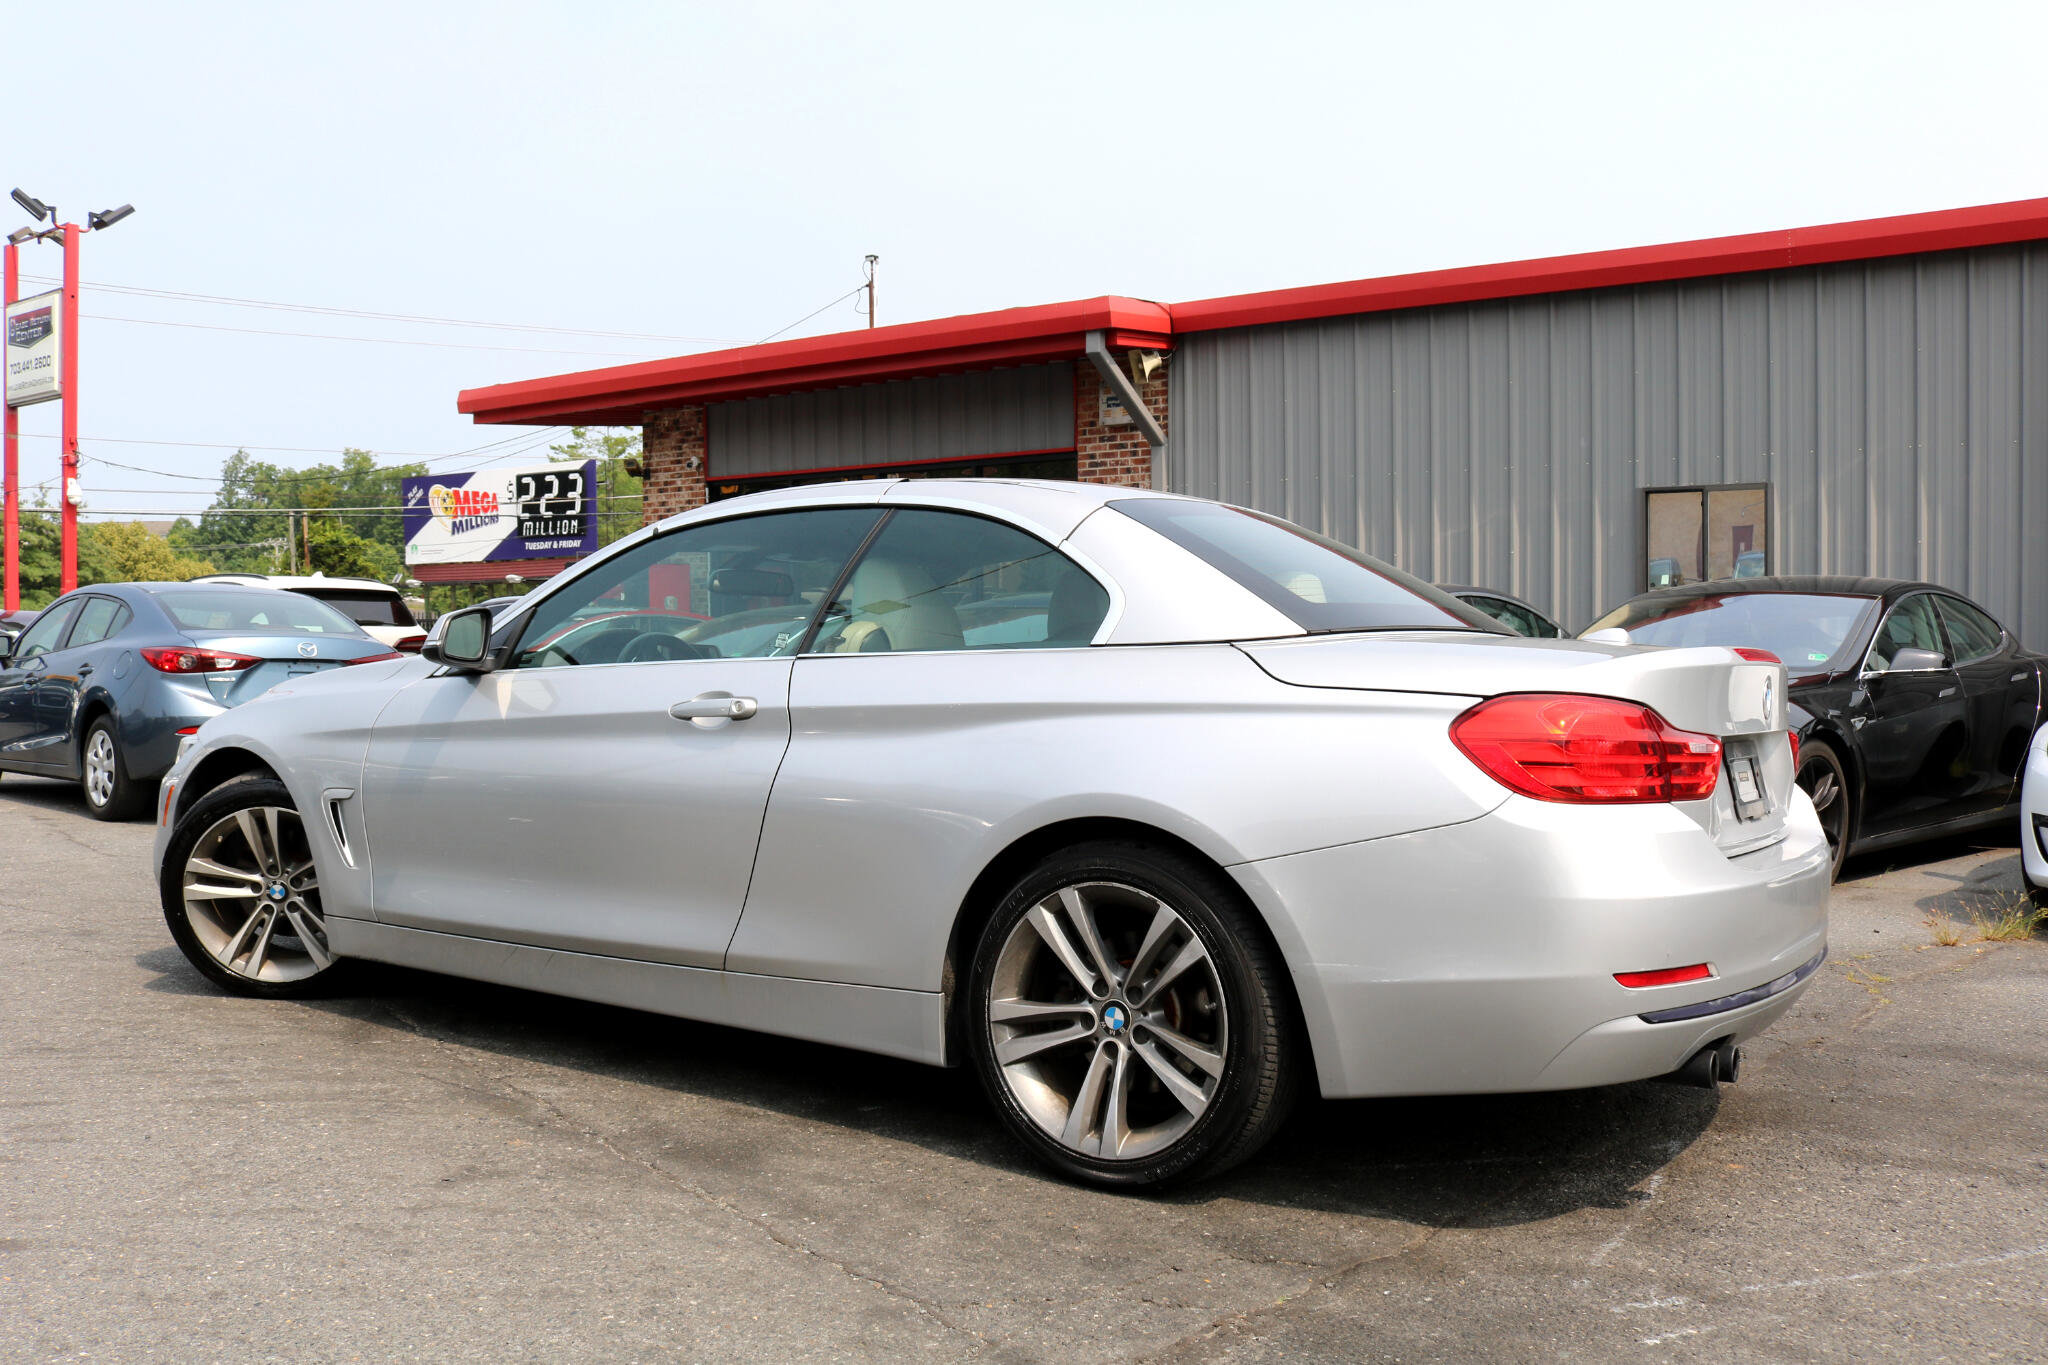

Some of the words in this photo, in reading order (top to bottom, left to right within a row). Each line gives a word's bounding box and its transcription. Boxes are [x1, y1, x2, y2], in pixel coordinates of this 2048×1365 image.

[452, 489, 499, 519] MEGA
[518, 473, 583, 519] 223
[452, 514, 499, 536] MILLIONS
[523, 519, 578, 536] MILLION
[525, 541, 552, 550] TUESDAY
[553, 541, 558, 549] &
[559, 540, 582, 548] FRIDAY
